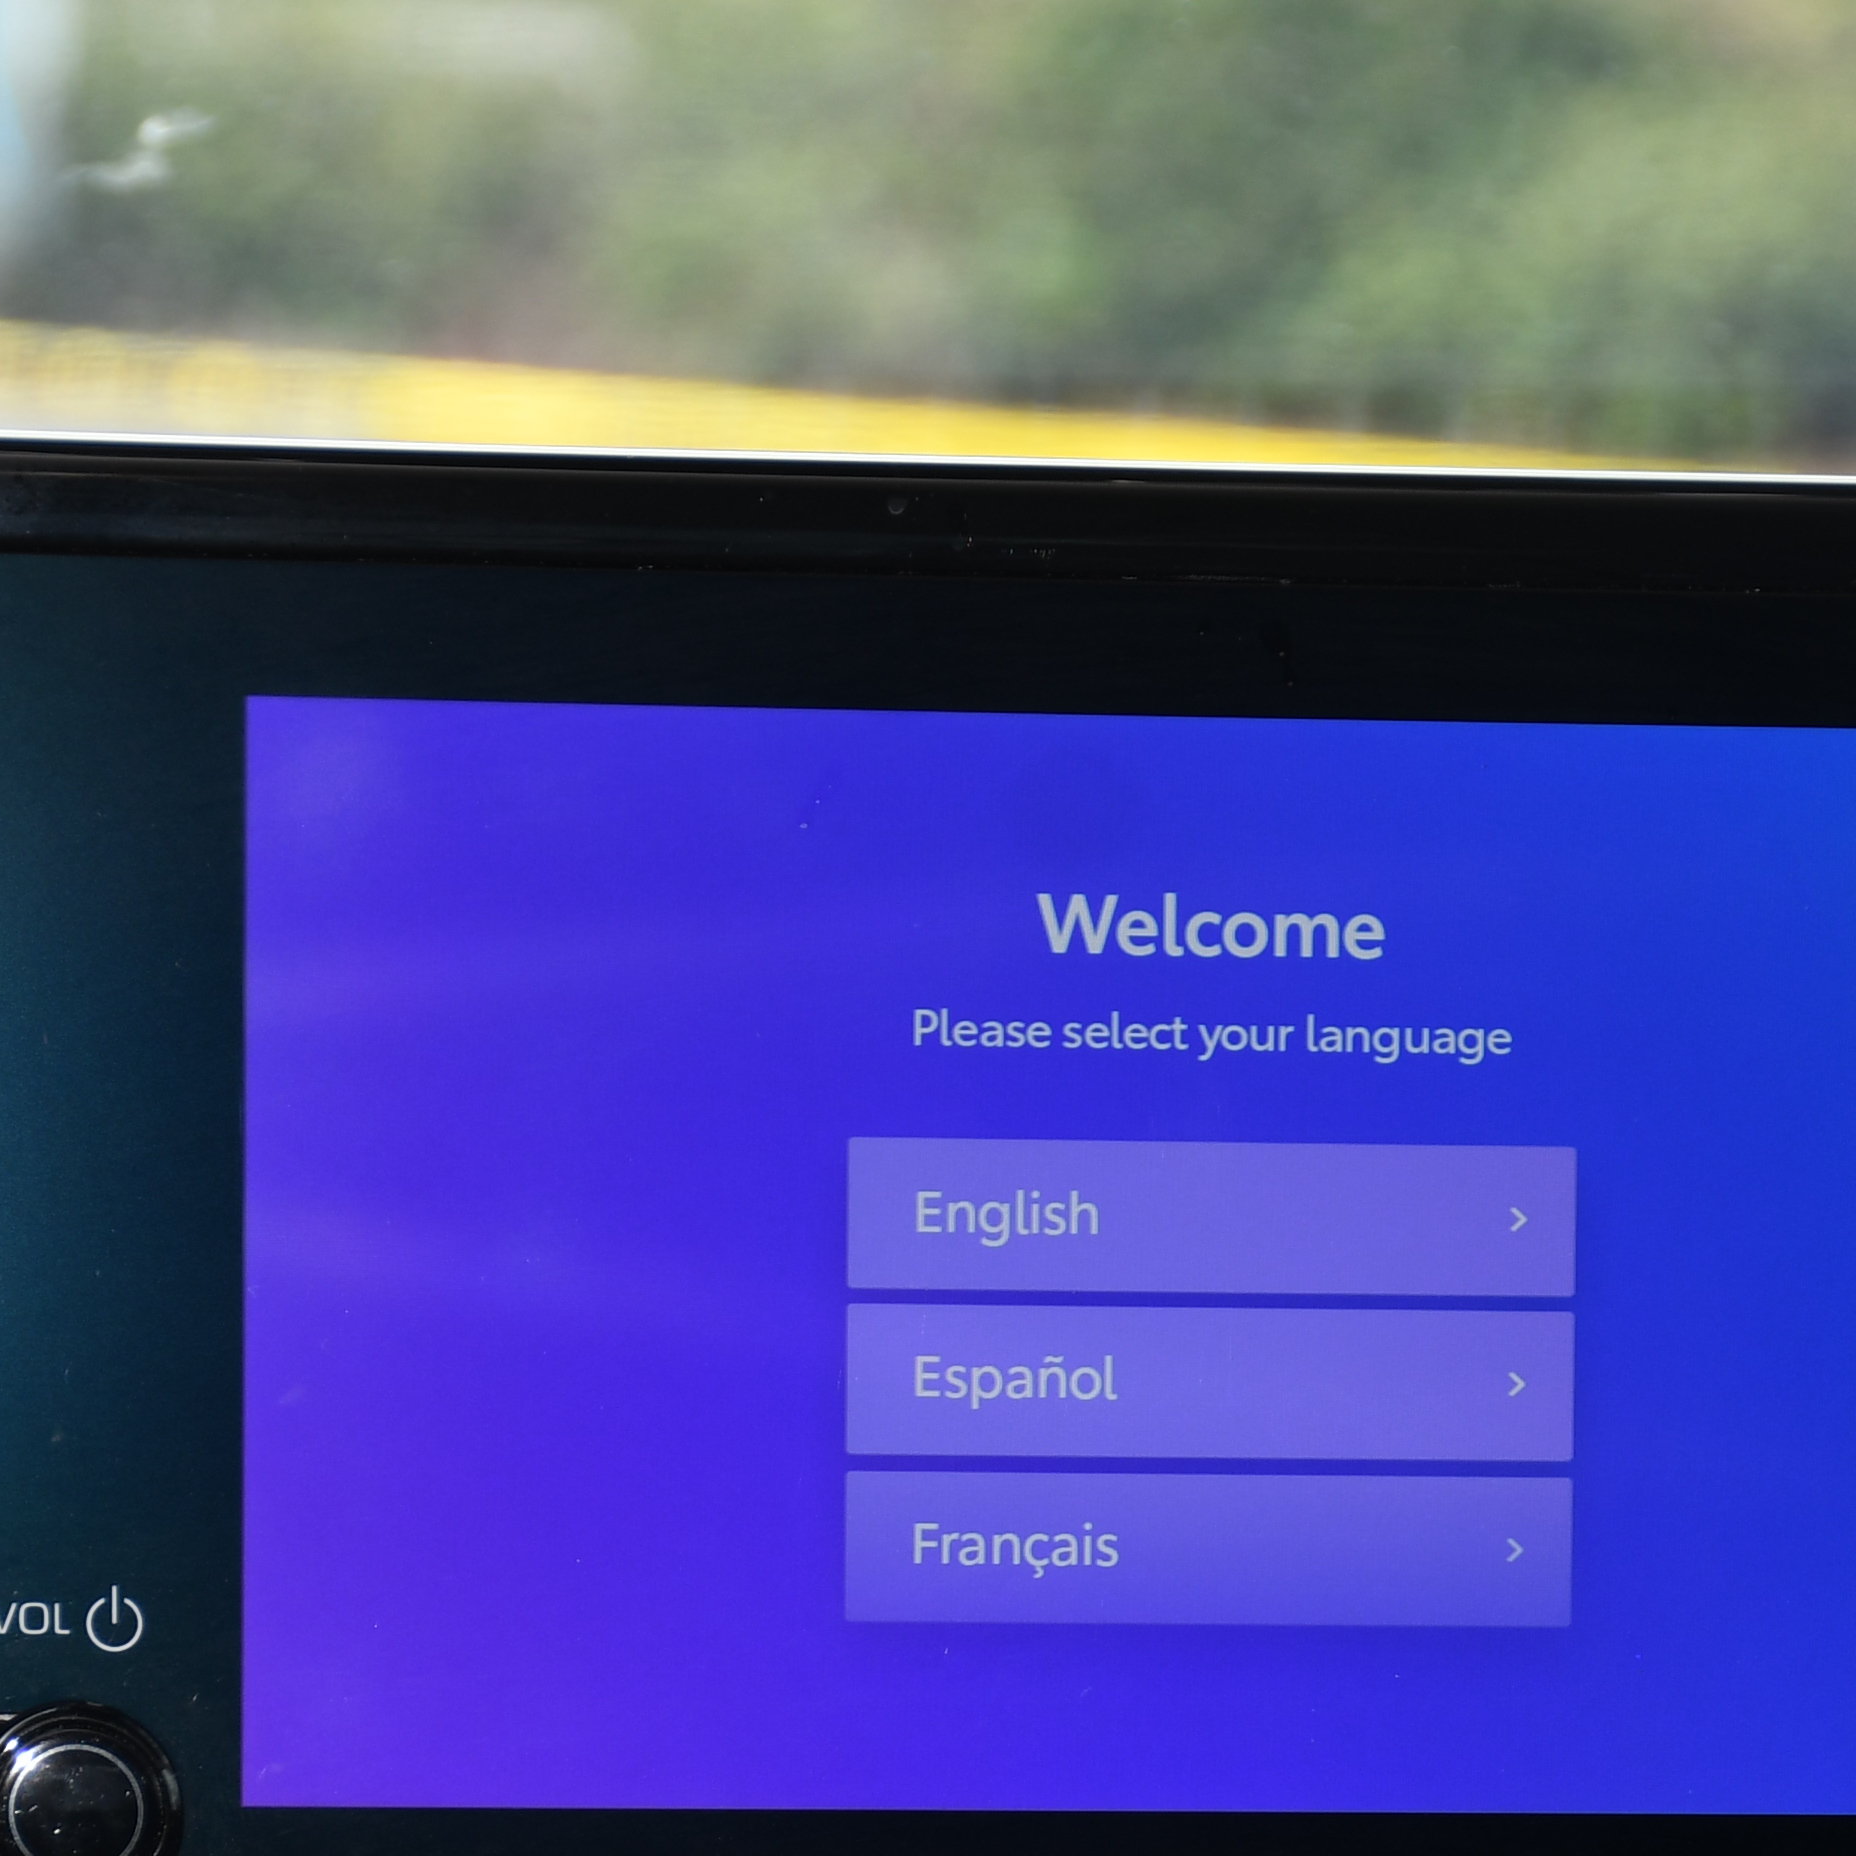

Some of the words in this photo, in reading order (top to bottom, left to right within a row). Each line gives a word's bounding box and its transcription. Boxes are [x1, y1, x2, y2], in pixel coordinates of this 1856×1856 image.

[1036, 892, 1385, 960] Welcome
[913, 1008, 1052, 1048] Please
[1062, 1010, 1189, 1050] select
[1198, 1024, 1295, 1061] your
[1306, 1013, 1513, 1065] language
[916, 1189, 1099, 1247] English
[914, 1355, 1118, 1410] Español
[913, 1522, 1119, 1579] Français
